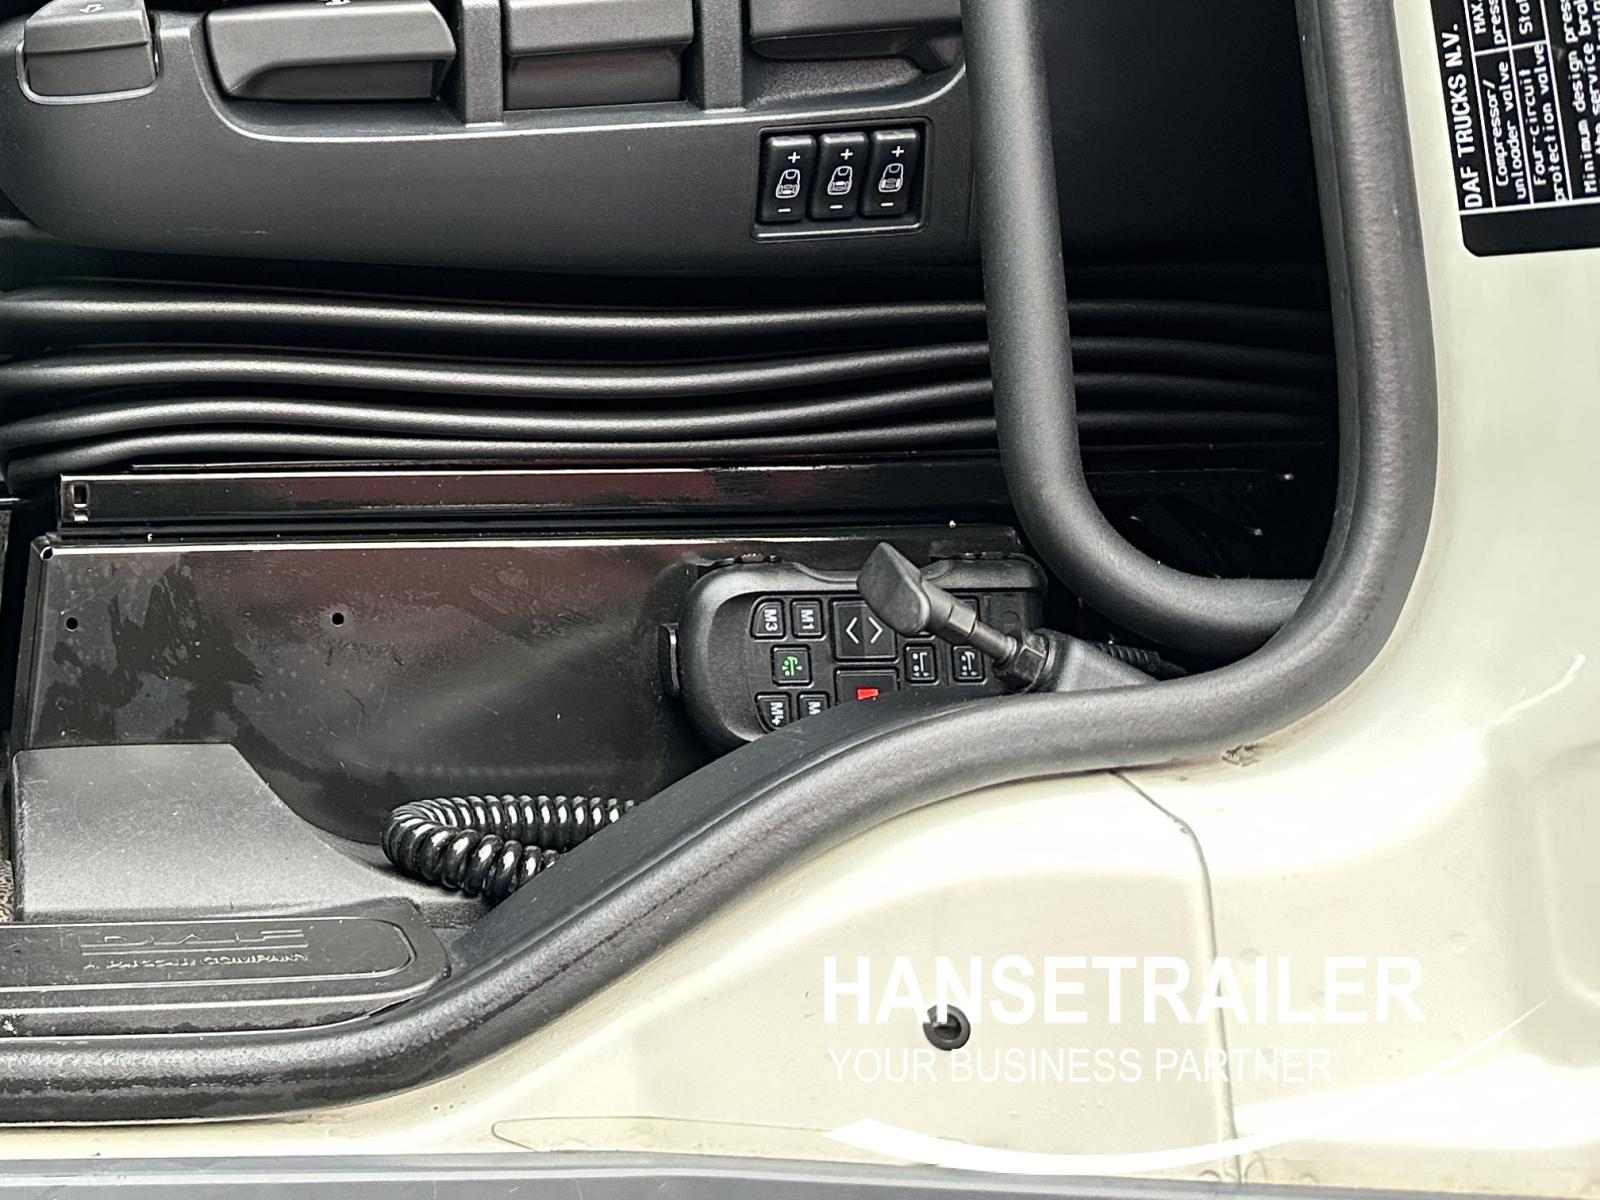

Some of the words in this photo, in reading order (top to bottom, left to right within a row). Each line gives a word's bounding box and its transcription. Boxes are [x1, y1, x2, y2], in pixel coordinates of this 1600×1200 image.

[1442, 24, 1463, 67] N.V.
[1531, 42, 1549, 95] valve
[1499, 62, 1513, 111] valve
[1568, 51, 1586, 112] design
[1583, 43, 1600, 115] service
[1448, 74, 1475, 158] TRUCKS
[1483, 80, 1508, 186] Compressor/
[1519, 70, 1546, 185] Four-circuit
[1507, 120, 1526, 199] unloader
[1543, 103, 1569, 203] protection
[1578, 120, 1597, 193] Minimum
[1460, 167, 1482, 207] DAF
[764, 609, 778, 631] M3
[801, 609, 814, 630] M1
[770, 701, 784, 725] M4
